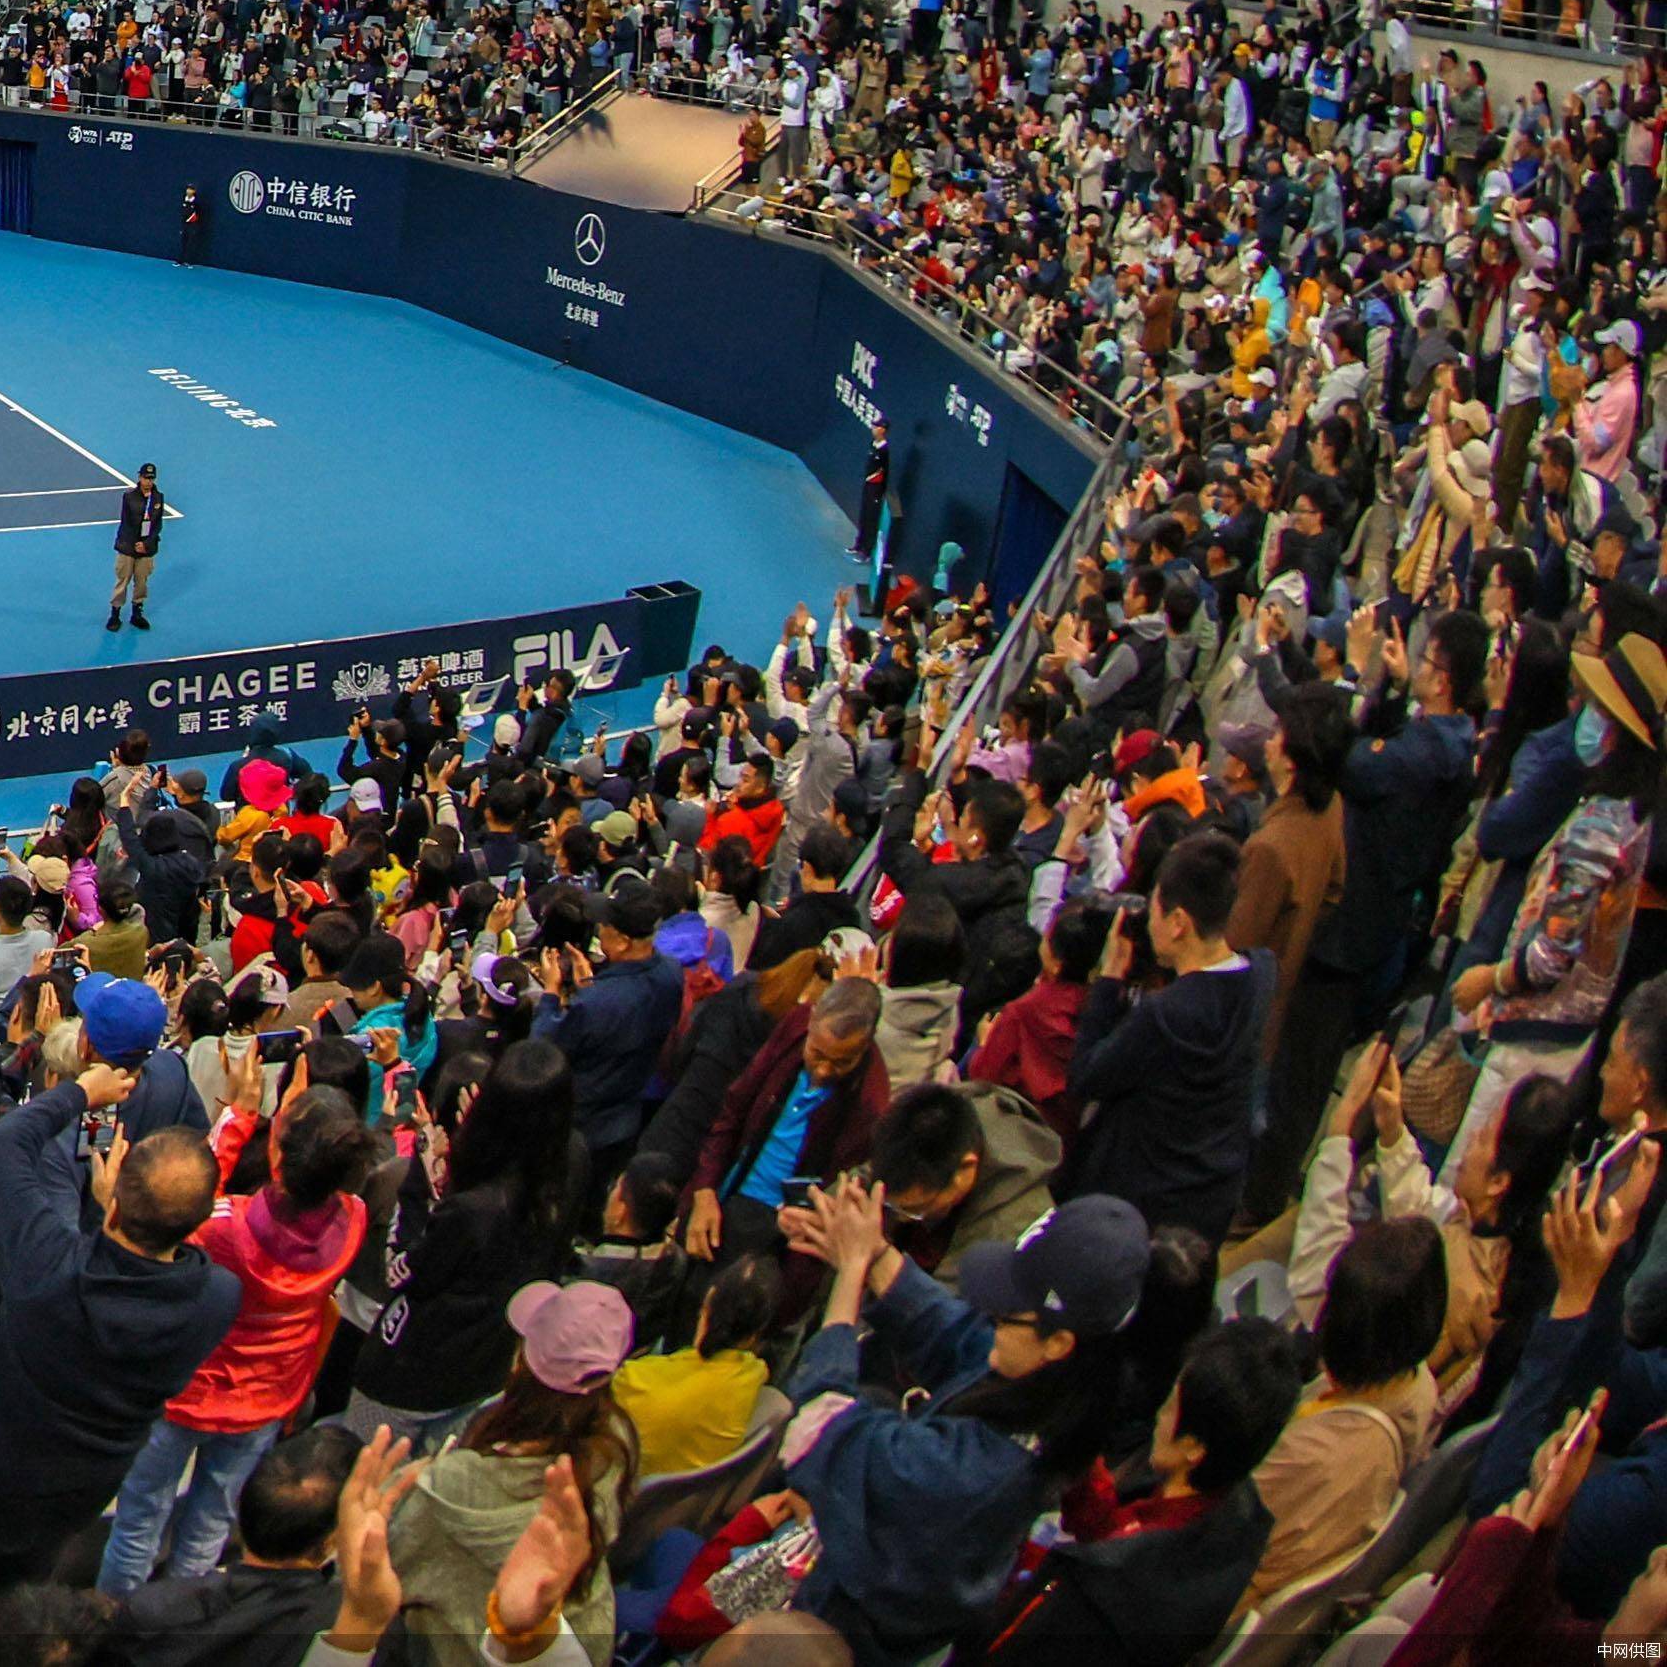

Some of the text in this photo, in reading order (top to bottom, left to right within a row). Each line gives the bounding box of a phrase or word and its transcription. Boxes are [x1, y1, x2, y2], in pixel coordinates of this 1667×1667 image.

[82, 136, 96, 144] 1000
[105, 131, 133, 143] ATP
[120, 142, 133, 151] 500
[267, 176, 356, 212] 中信银行
[266, 205, 353, 226] CHINA CITIC BANK
[546, 266, 625, 307] Mercedes-Benz
[564, 302, 600, 327] 北京奔驰
[852, 341, 877, 389] PICC
[148, 368, 277, 430] BEIJING 北京
[513, 622, 622, 686] FILA
[148, 661, 316, 708] CHAGEE
[453, 671, 484, 686] BEER
[6, 698, 134, 741] 北京同仁堂
